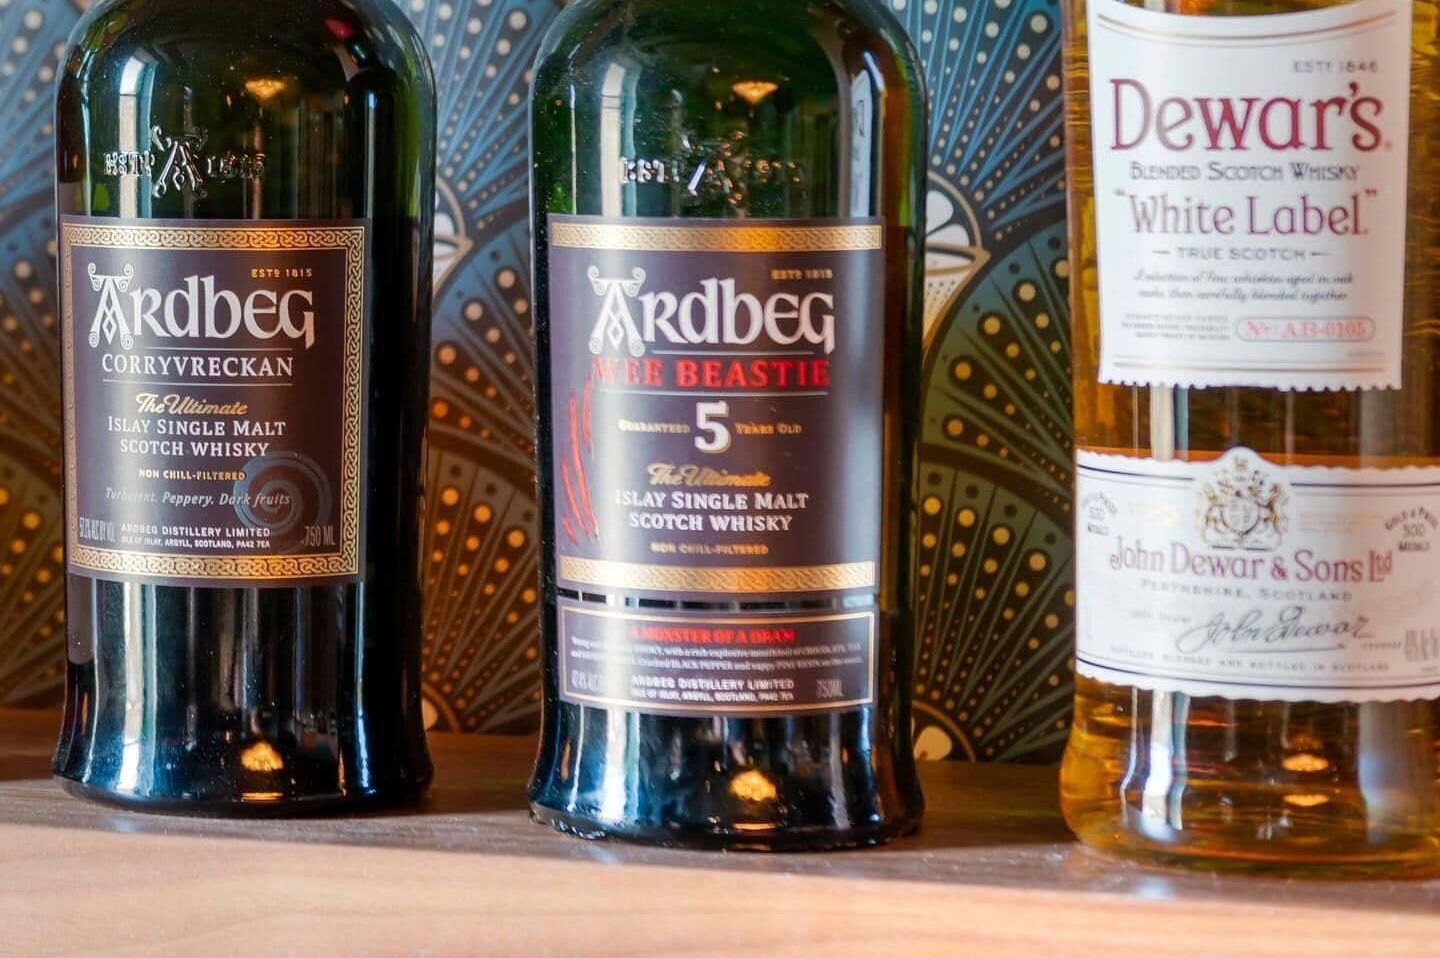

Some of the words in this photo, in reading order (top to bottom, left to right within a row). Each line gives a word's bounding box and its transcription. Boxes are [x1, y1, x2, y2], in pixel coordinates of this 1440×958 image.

[1110, 78, 1384, 153] Dewar's
[1129, 161, 1201, 181] BLENDED
[1207, 162, 1284, 181] SCOTCH
[1288, 162, 1360, 181] WHISKY
[1178, 247, 1224, 260] TRUE
[1229, 247, 1306, 261] SCOTCH
[285, 268, 313, 278] 1815
[102, 353, 294, 377] CORRYVRECKAN
[593, 357, 664, 386] WEE
[676, 359, 830, 387] BEASTIE
[136, 392, 166, 414] The
[164, 393, 248, 416] Ultimate
[108, 416, 151, 434] ISLAY
[157, 418, 225, 437] SINGLE
[233, 420, 286, 437] MALT
[694, 400, 732, 454] 5
[735, 422, 774, 435] YEARS
[778, 423, 802, 434] OLD
[120, 438, 184, 457] SCOTCH
[191, 441, 270, 458] WHISKY
[139, 470, 159, 479] NON
[163, 470, 246, 481] CHILL-FILTERED
[647, 462, 683, 486] The
[162, 491, 214, 508] Peppery.
[219, 493, 251, 506] Dark
[252, 493, 290, 508] fruits
[616, 489, 667, 508] ISLAY
[671, 491, 748, 510] SINGLE
[754, 492, 809, 510] MALT
[121, 523, 158, 534] ARDBEG
[162, 525, 222, 538] DISTILLERY
[225, 527, 270, 537] LIMITED
[628, 512, 703, 531] SCOTCH
[710, 514, 792, 531] WHISKY
[164, 538, 192, 549] ARGYLL,
[194, 539, 234, 550] SCOTLAND,
[680, 543, 769, 555] CHILL-FILTERED
[1110, 536, 1166, 571] John
[1170, 541, 1266, 580] Dewar
[1271, 553, 1288, 581] &
[1294, 548, 1364, 584] Sons
[1369, 548, 1392, 583] Ltd
[641, 627, 712, 643] MONSTER
[714, 629, 734, 644] OF
[736, 629, 747, 644] A
[750, 628, 795, 644] DRAM
[678, 678, 745, 691] DISTILLERY
[747, 679, 794, 691] LIMITED
